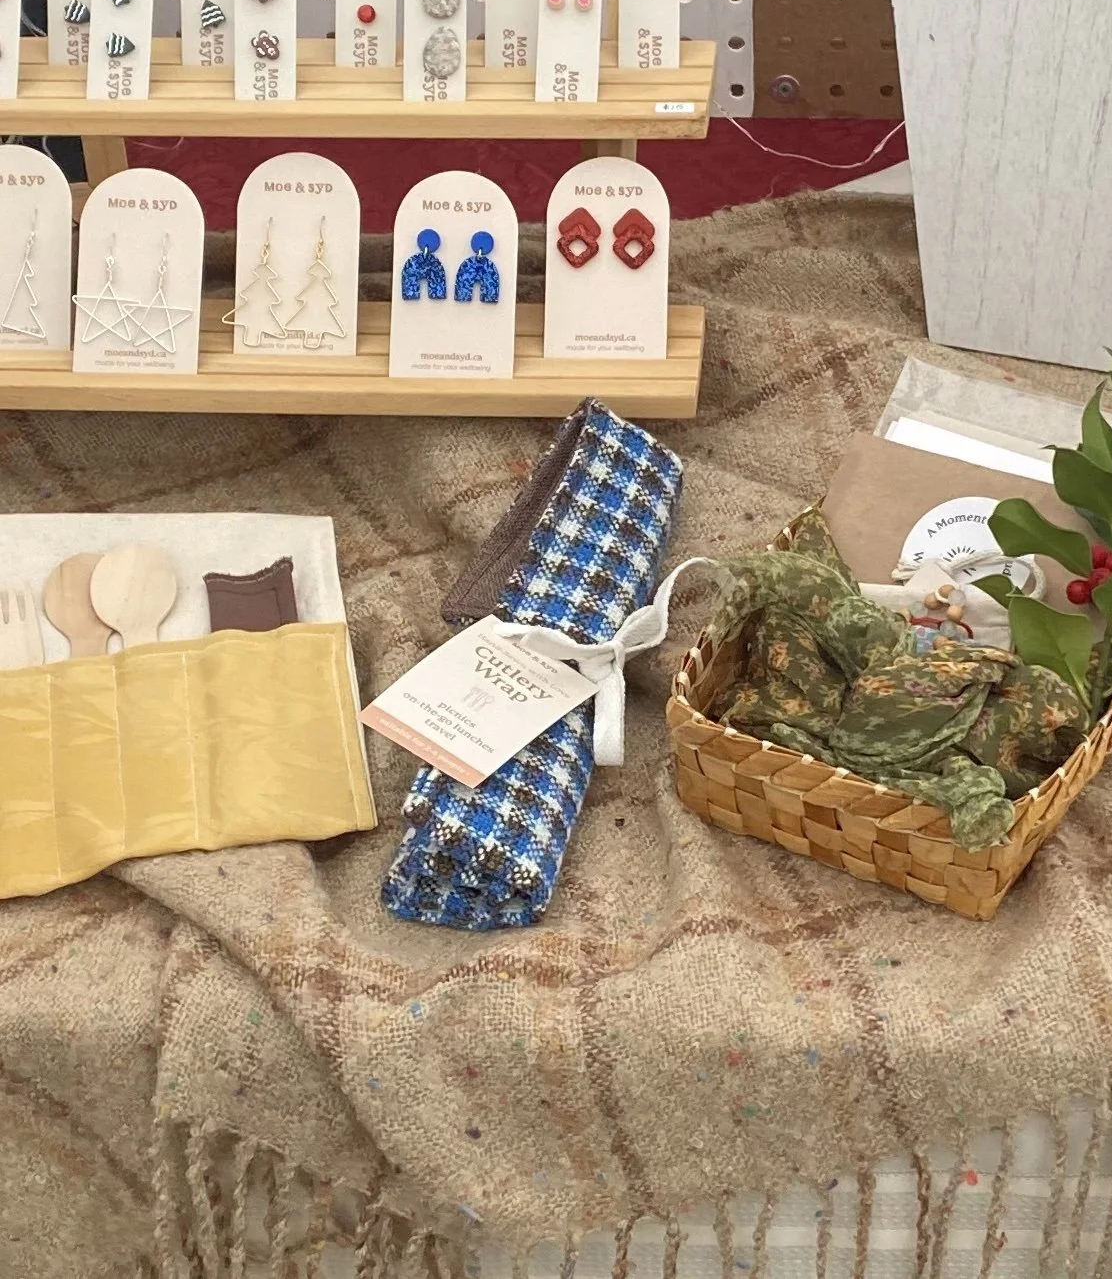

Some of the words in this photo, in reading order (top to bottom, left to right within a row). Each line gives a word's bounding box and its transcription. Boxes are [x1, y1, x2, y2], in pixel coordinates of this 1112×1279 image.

[67, 26, 79, 37] &
[199, 28, 212, 38] &
[353, 28, 366, 39] &
[503, 29, 515, 39] &
[638, 28, 650, 39] &
[108, 59, 120, 69] &
[254, 61, 266, 72] &
[554, 63, 567, 74] &
[295, 182, 305, 193] &
[605, 186, 615, 197] &
[139, 199, 150, 210] &
[453, 201, 463, 212] &
[575, 333, 637, 343] moeandsyd.ca
[104, 349, 167, 359] moeandsyd.ca
[420, 353, 483, 363] moeandsyd.ca
[927, 528, 937, 538] A
[935, 514, 987, 530] Moment
[475, 646, 553, 700] Cutlery
[475, 660, 528, 702] Wrap
[437, 702, 477, 729] picnics
[424, 718, 457, 741] travel
[453, 723, 495, 755] lunches
